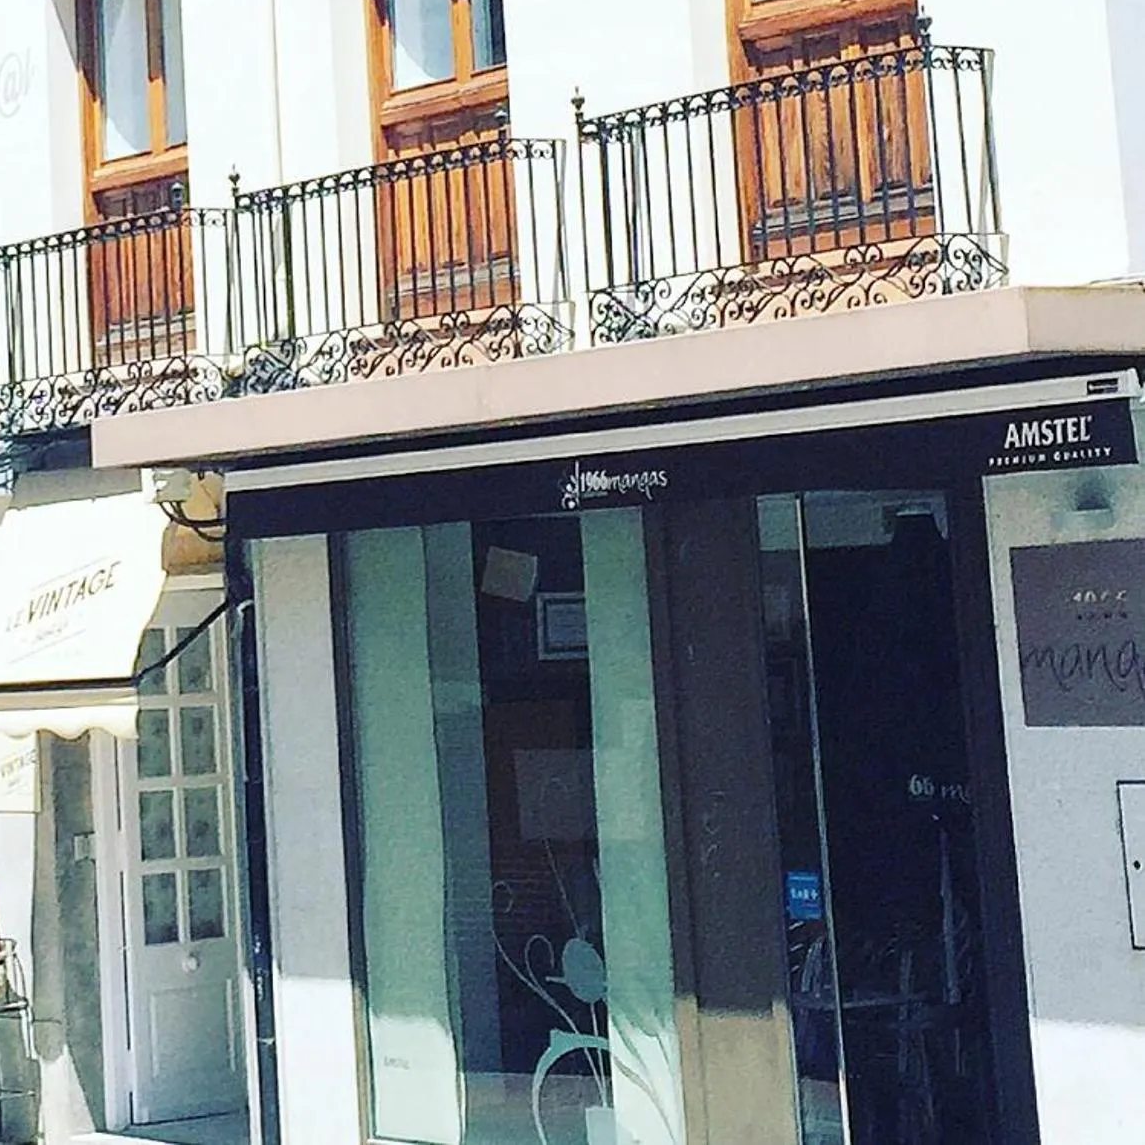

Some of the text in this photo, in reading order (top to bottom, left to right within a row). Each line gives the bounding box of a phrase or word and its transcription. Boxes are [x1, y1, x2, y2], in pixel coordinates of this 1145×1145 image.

[1004, 415, 1092, 449] AMSTEL
[988, 447, 1112, 466] PREMIUM QUALITY
[27, 560, 122, 624] VINTAGE
